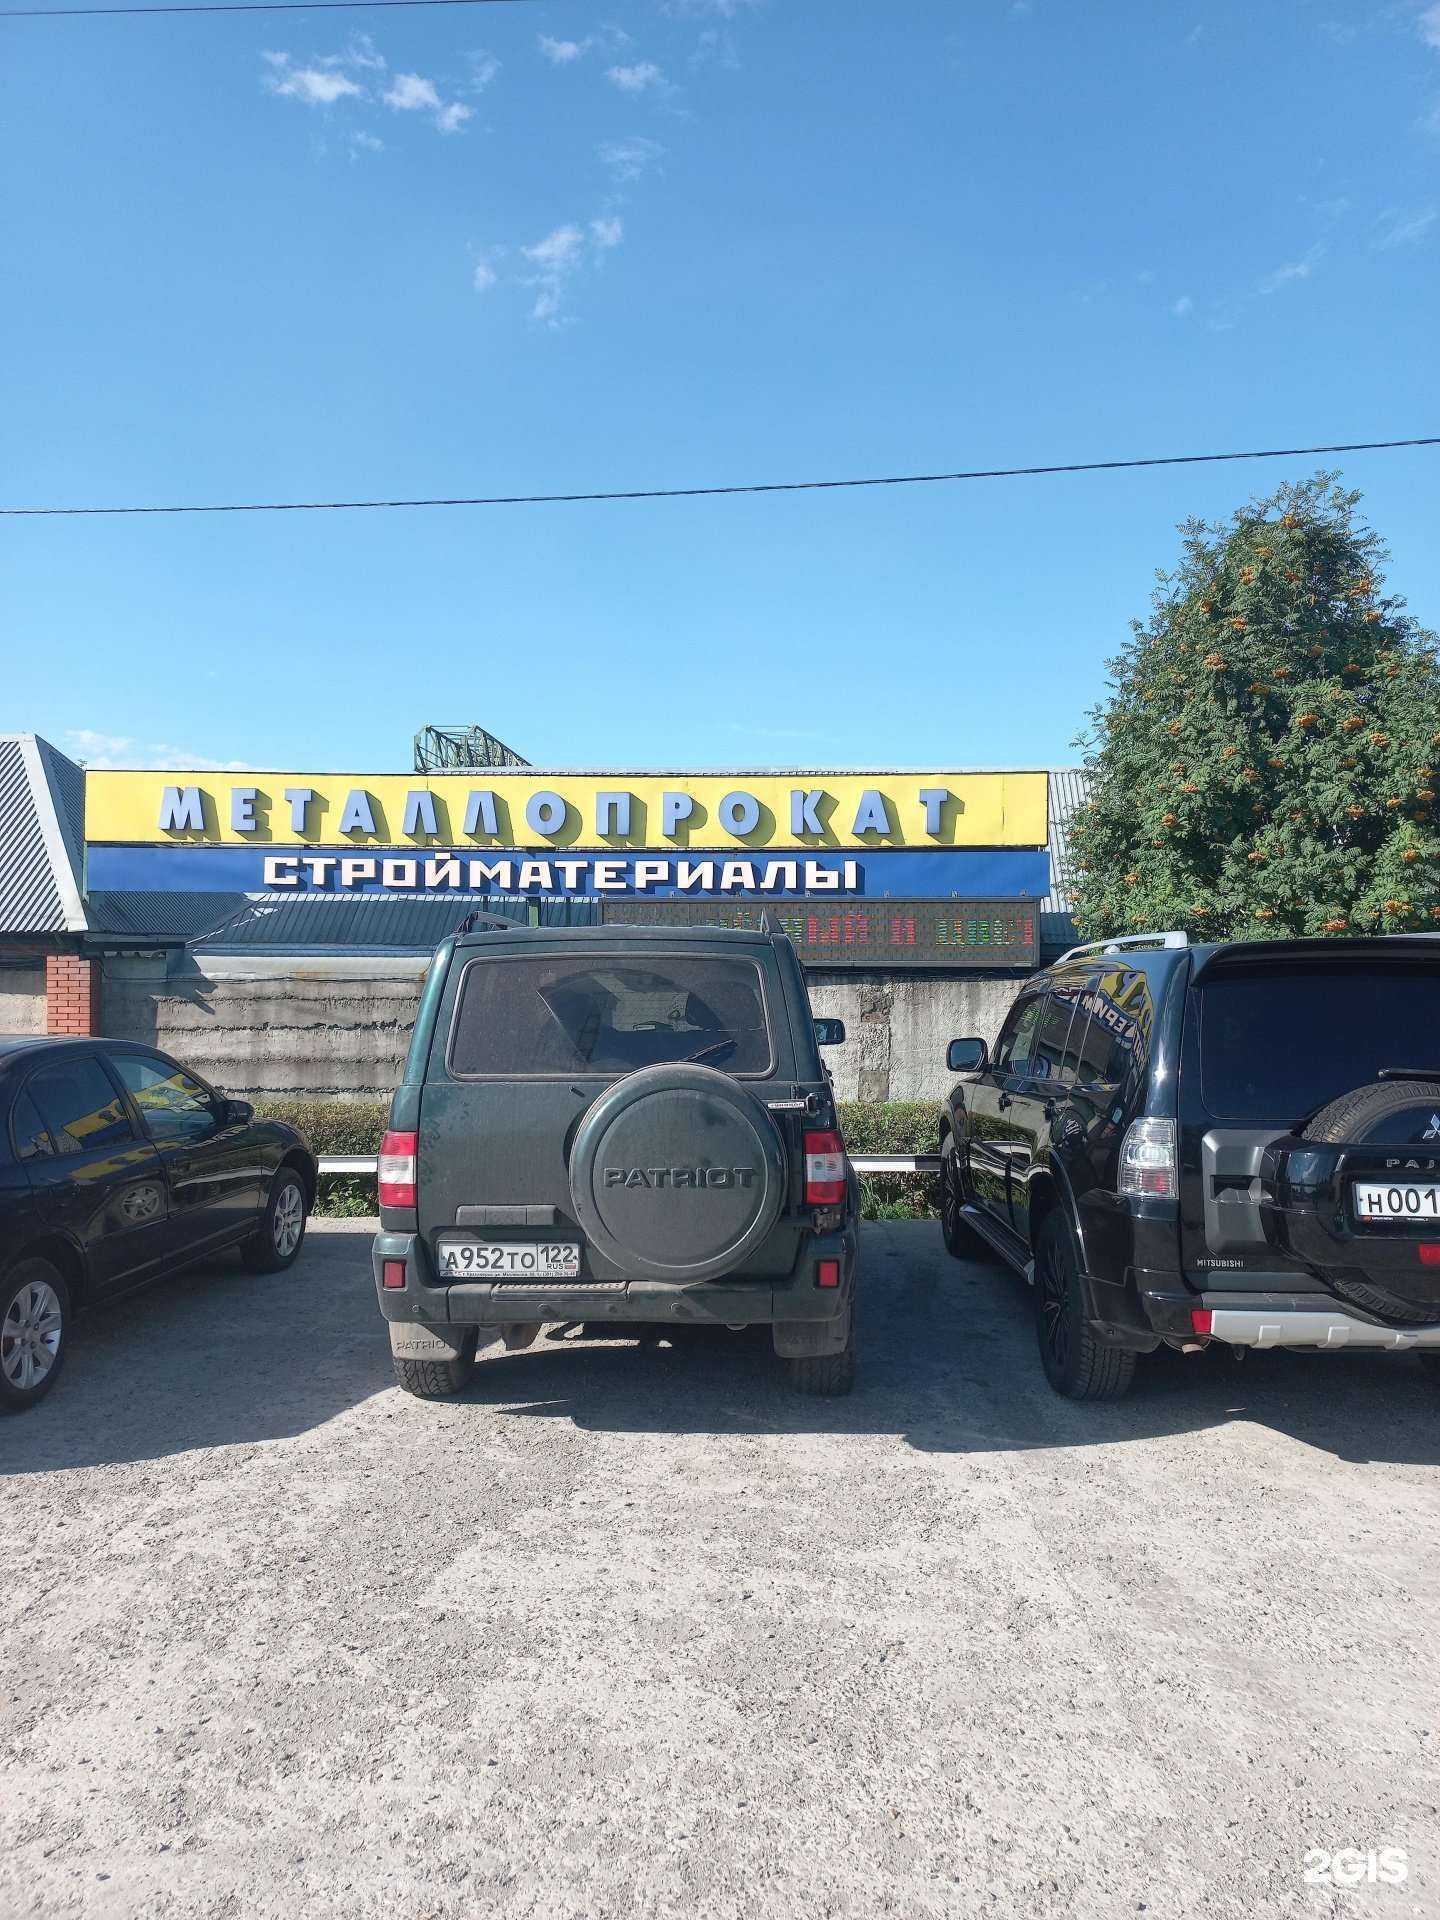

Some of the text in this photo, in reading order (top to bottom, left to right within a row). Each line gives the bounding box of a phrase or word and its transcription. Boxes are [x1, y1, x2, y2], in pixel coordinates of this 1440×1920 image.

[158, 786, 949, 837] МЕТАЛЛОПРОКАТ
[263, 852, 857, 890] СТРОЙМАТЕРИАЛЫ
[602, 1167, 755, 1189] PATRIOT
[540, 1245, 574, 1264] 122
[1196, 1258, 1244, 1268] MITSUBISHI
